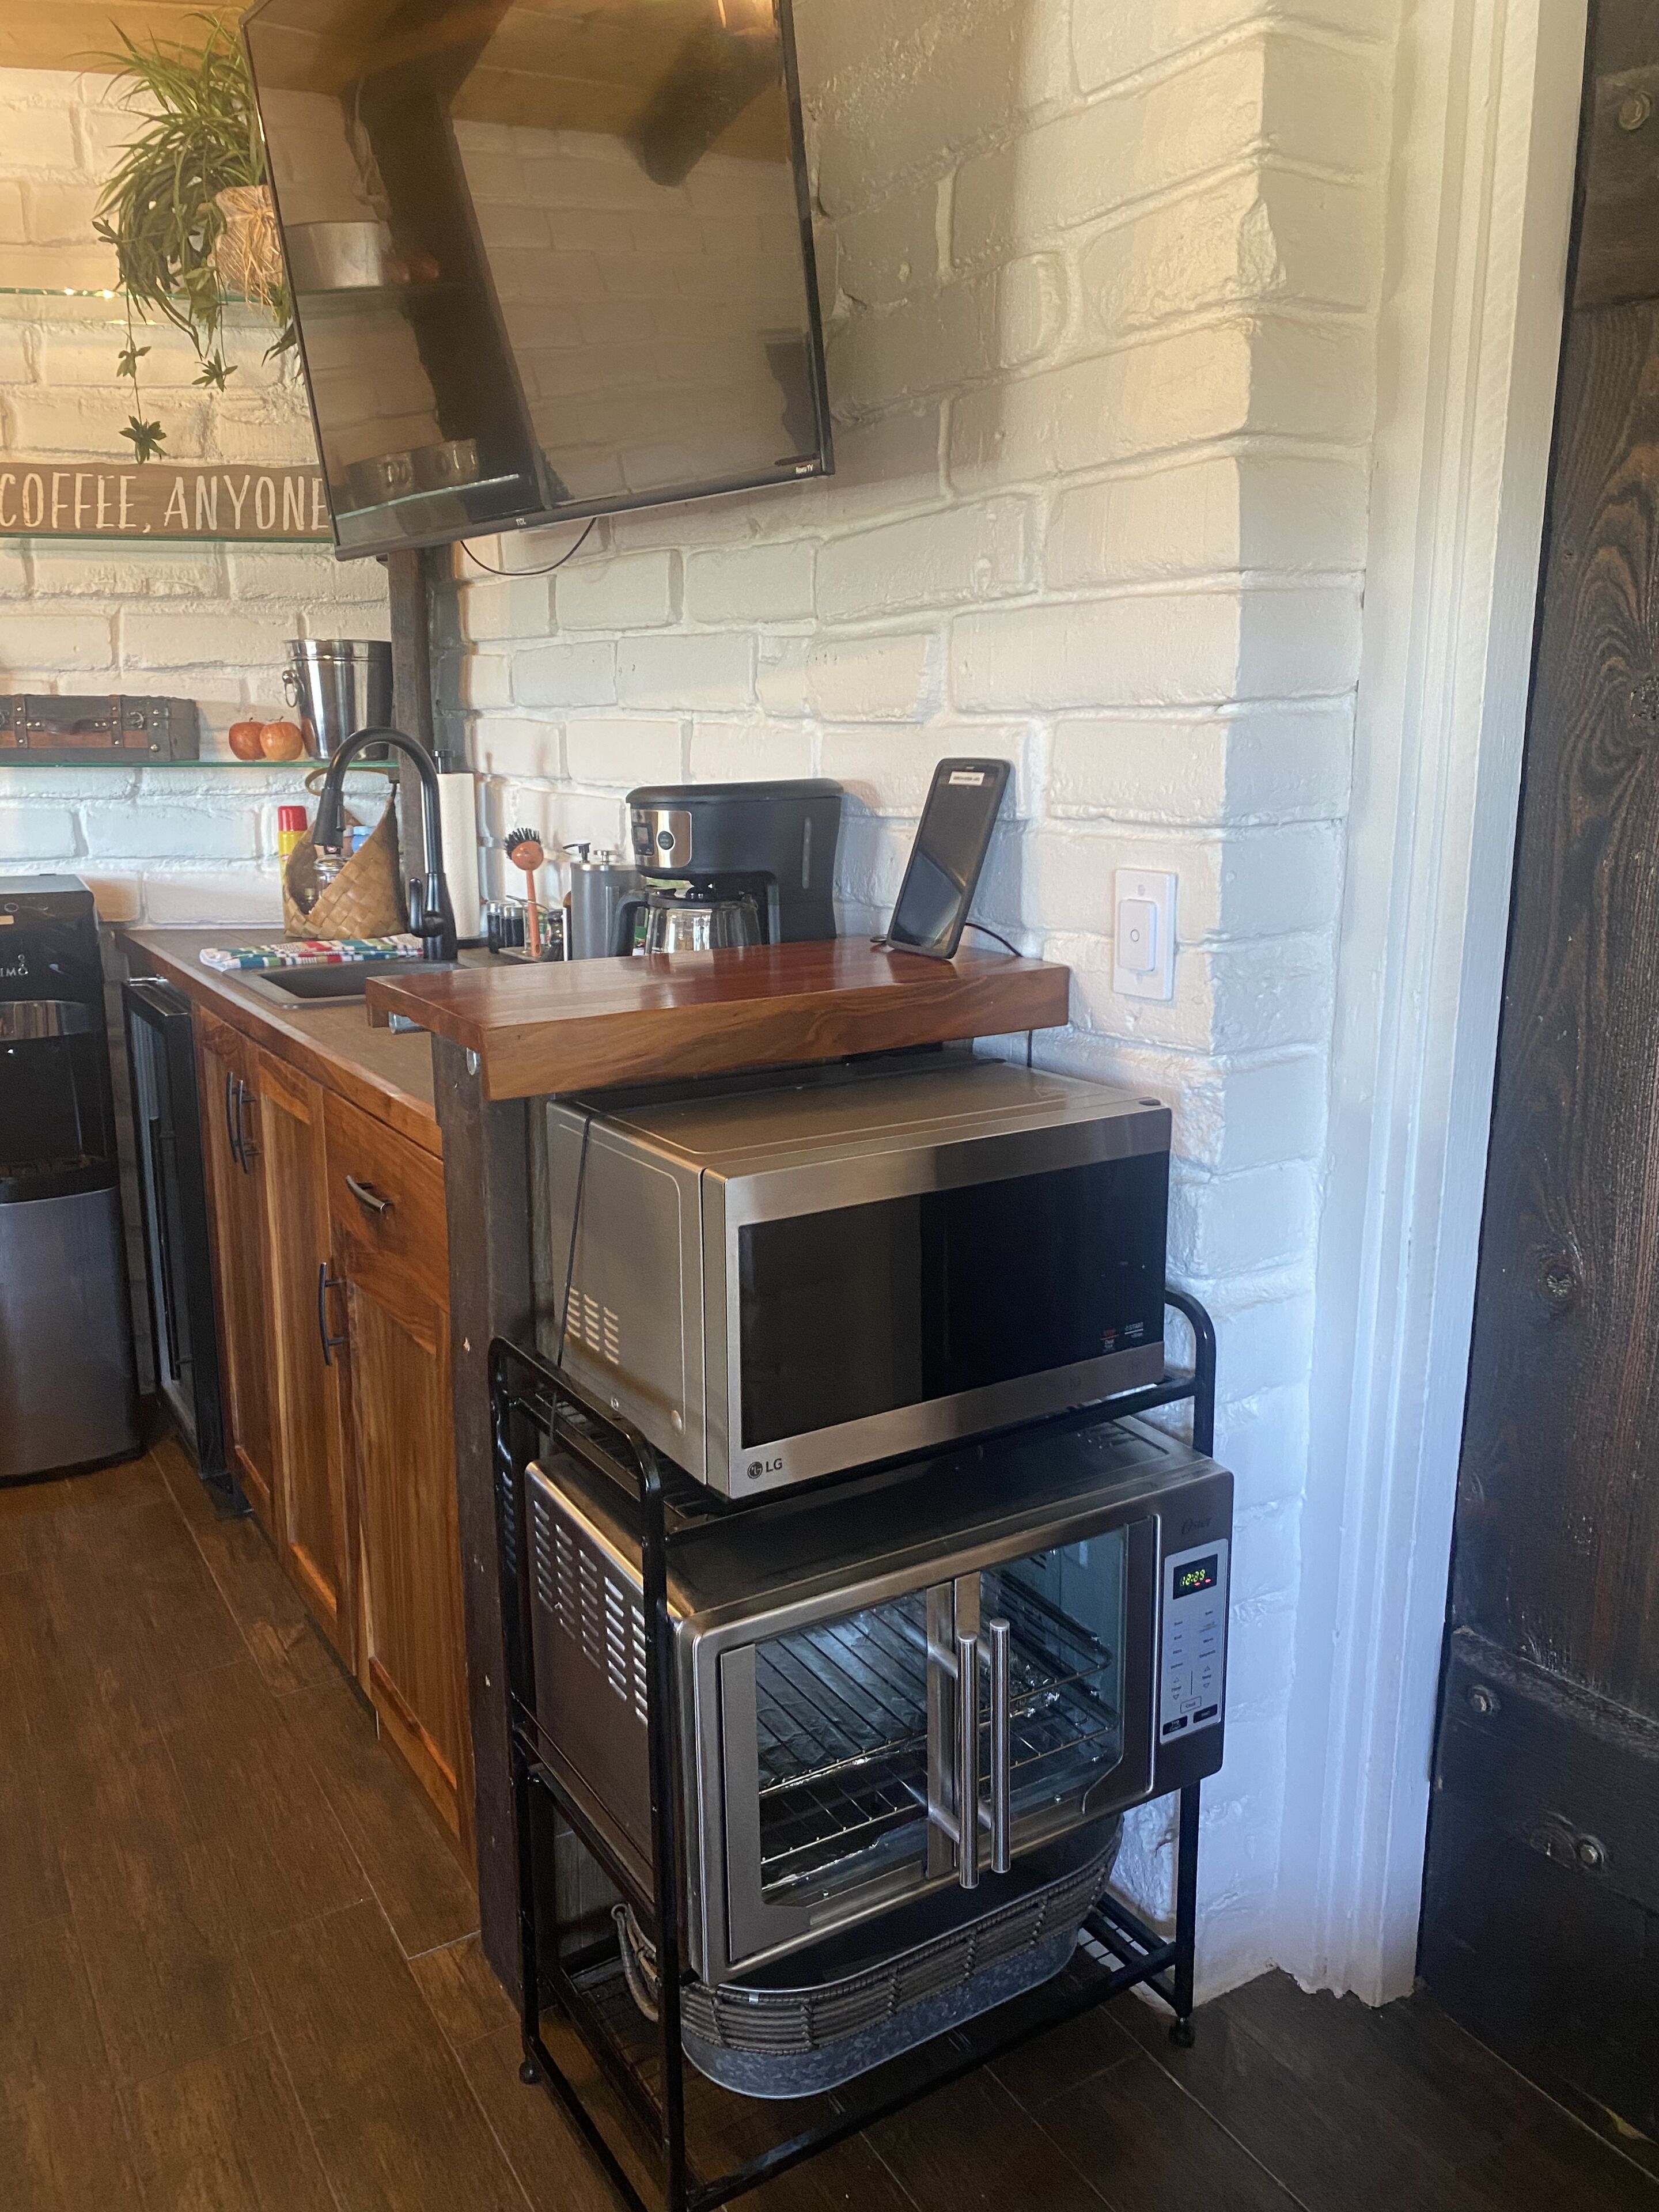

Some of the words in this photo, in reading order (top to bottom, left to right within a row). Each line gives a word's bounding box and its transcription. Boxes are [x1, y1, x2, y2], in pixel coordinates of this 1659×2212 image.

[0, 472, 151, 533] COFFEE,
[164, 475, 329, 531] ANYONE
[766, 1458, 783, 1472] LG
